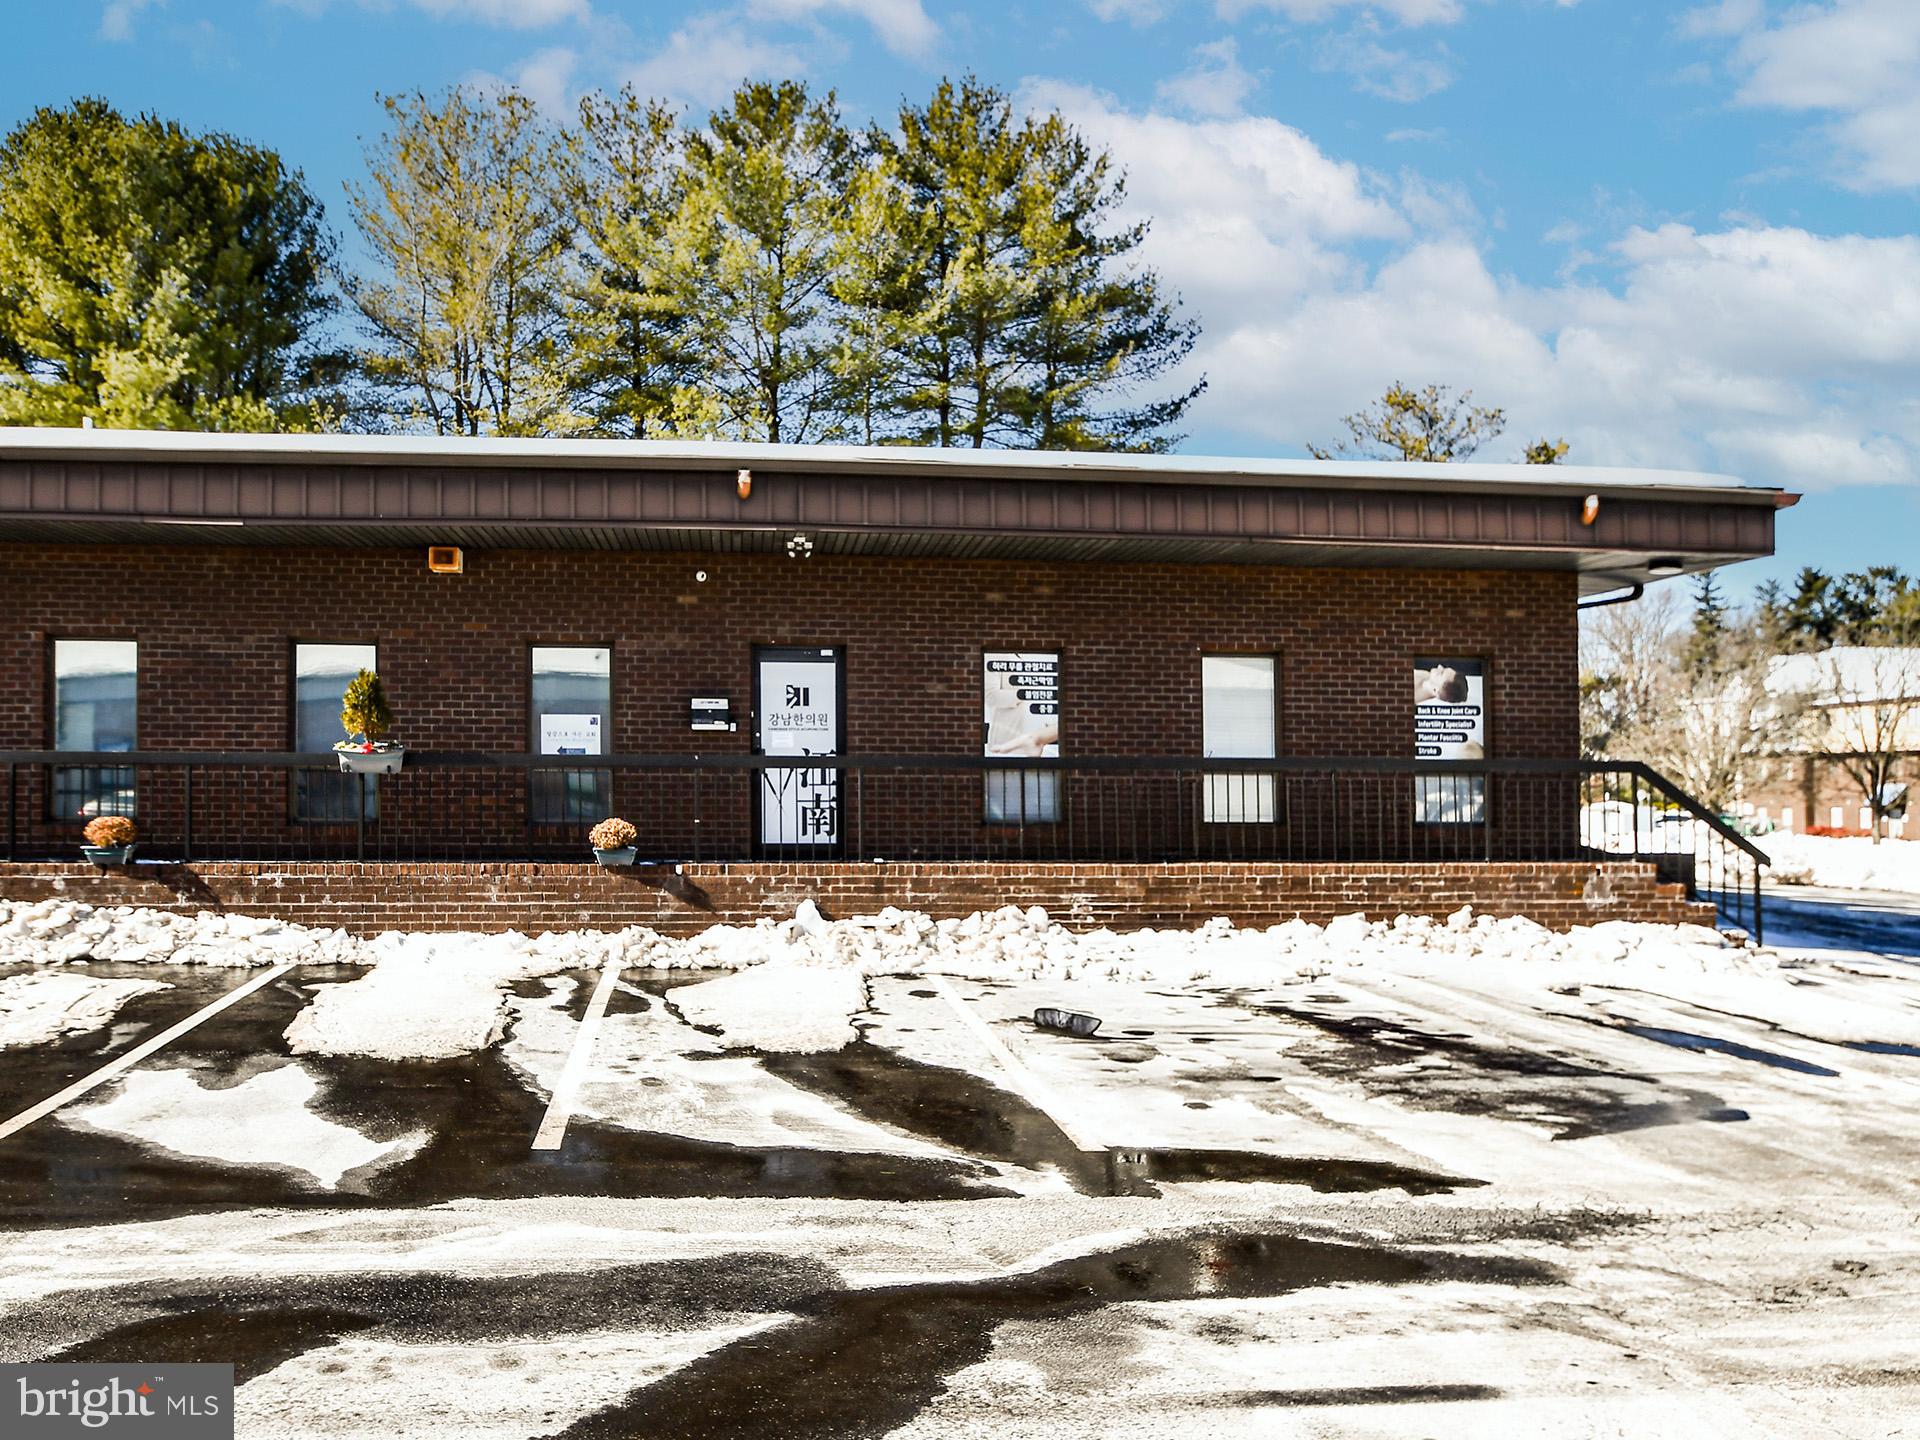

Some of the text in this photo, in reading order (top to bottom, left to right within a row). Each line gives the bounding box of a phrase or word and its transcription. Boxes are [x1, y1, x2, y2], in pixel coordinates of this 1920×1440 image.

[992, 661, 1007, 671] 허리
[1009, 662, 1023, 671] 무릎
[1417, 706, 1431, 715] Back
[1436, 707, 1451, 715] Knee
[1450, 707, 1464, 717] Joint
[1464, 707, 1478, 716] Care
[768, 713, 828, 727] 강남한의원
[1417, 720, 1473, 730] Infertility Specialist
[1418, 733, 1439, 742] Plantar
[1418, 747, 1438, 755] Stroke
